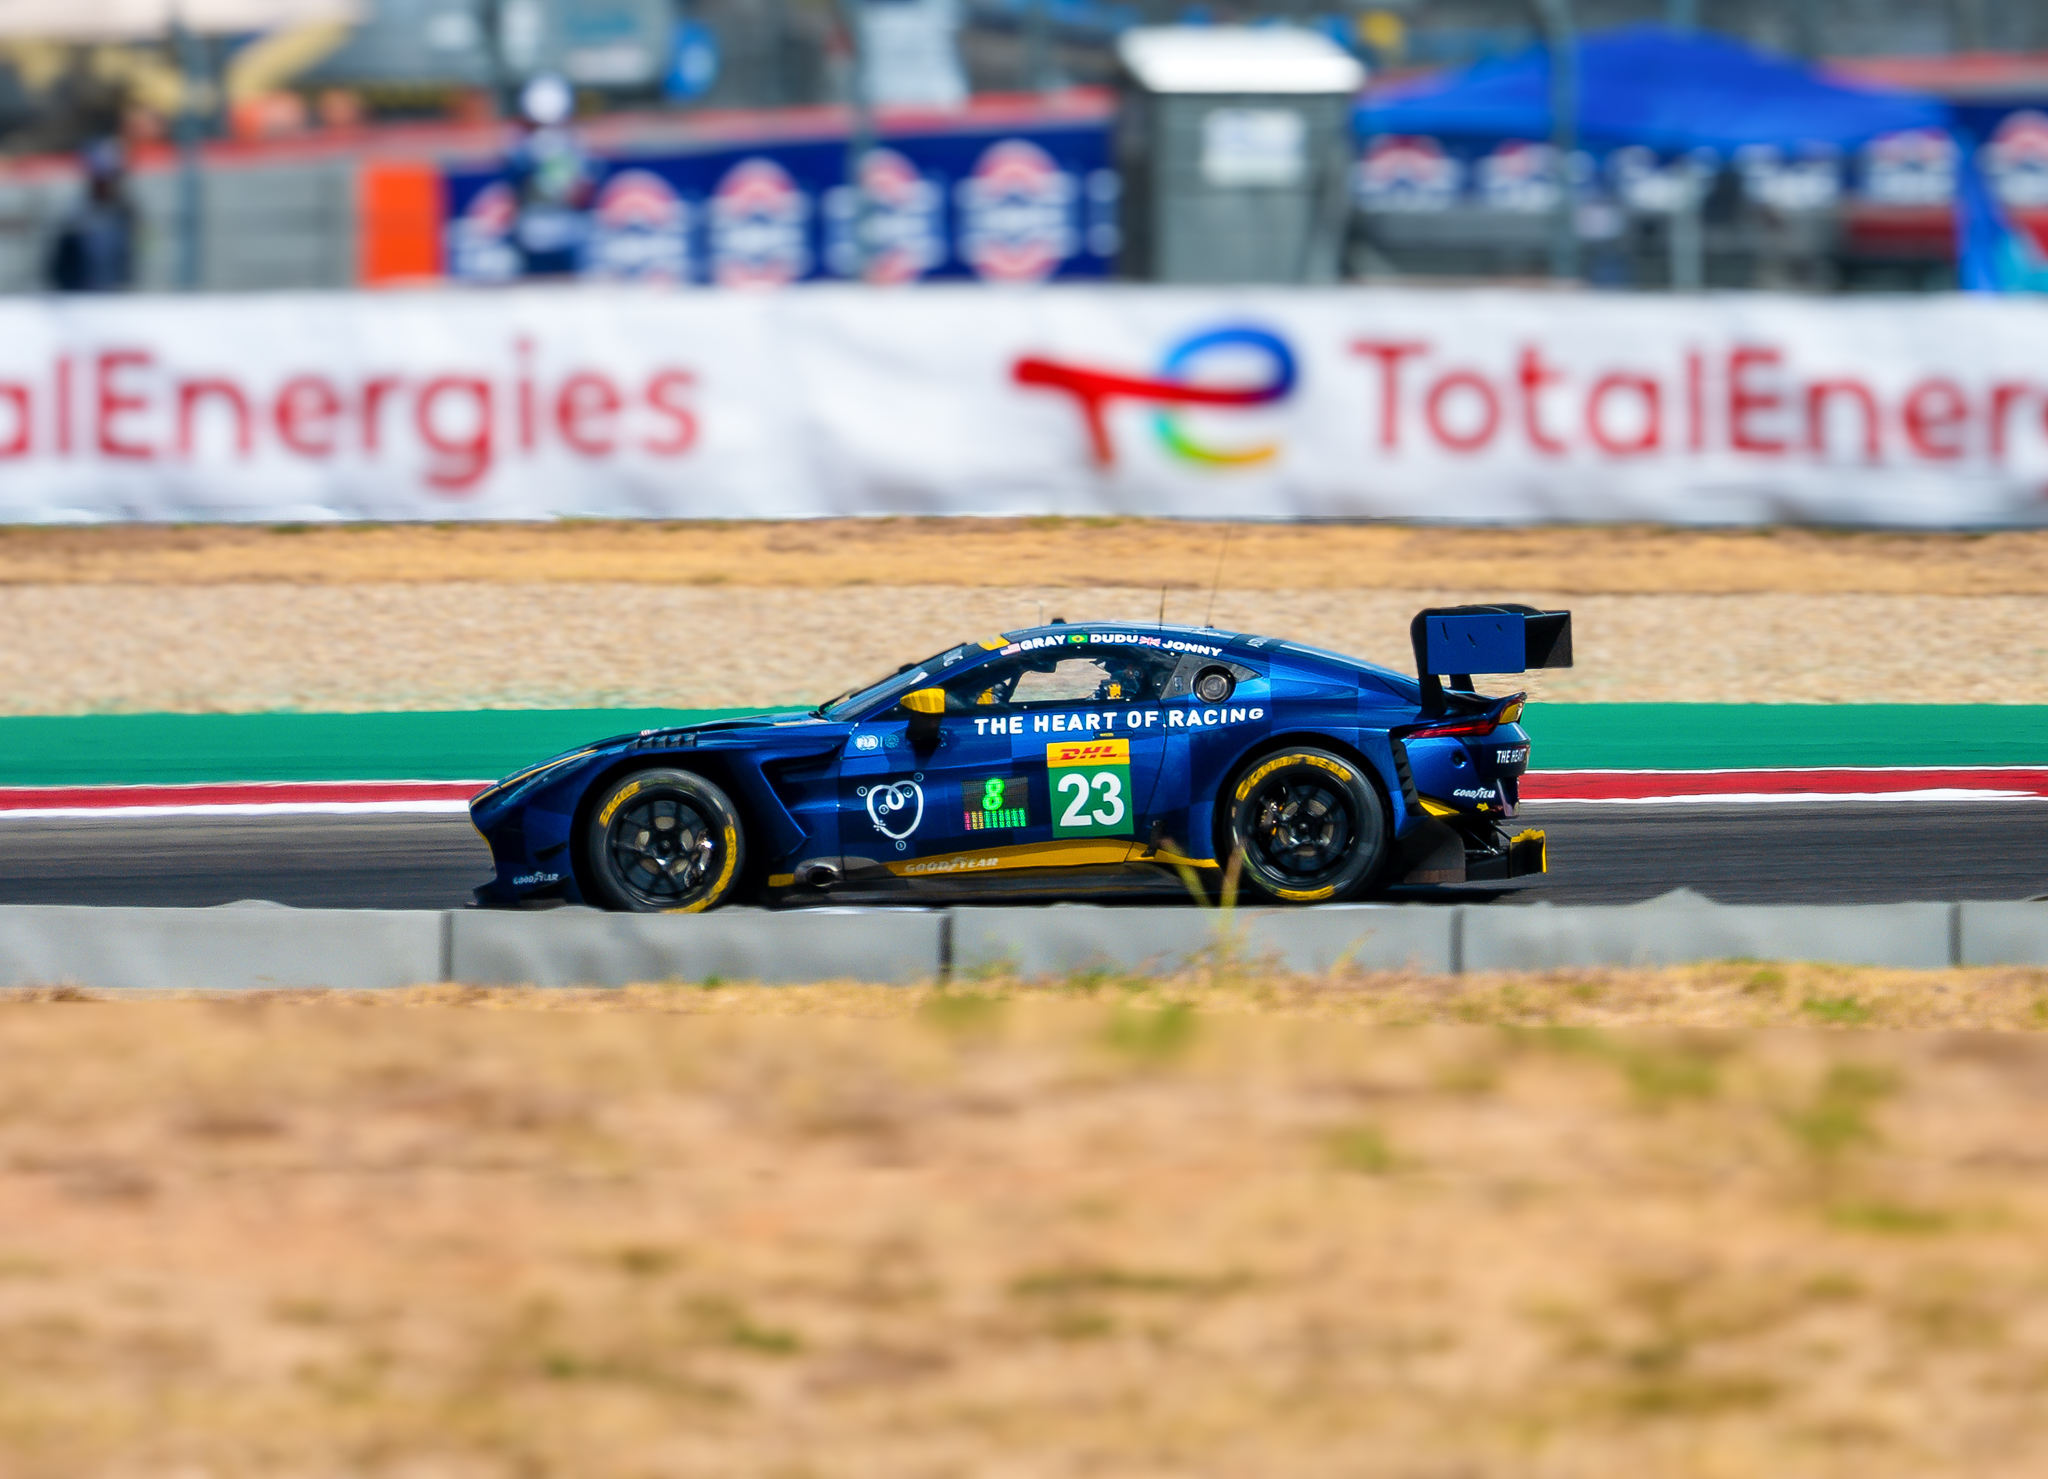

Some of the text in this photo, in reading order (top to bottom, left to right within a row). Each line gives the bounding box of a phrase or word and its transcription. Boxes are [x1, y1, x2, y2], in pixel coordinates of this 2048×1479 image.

[1350, 340, 2048, 502] TotalEner
[1020, 634, 1223, 657] GRAY DUDU JONNY
[974, 708, 1264, 735] THE HEART OF RACING
[1060, 746, 1118, 760] DHL
[982, 778, 1005, 811] 8
[1058, 772, 1125, 827] 23
[905, 856, 999, 873] GOODYEAR
